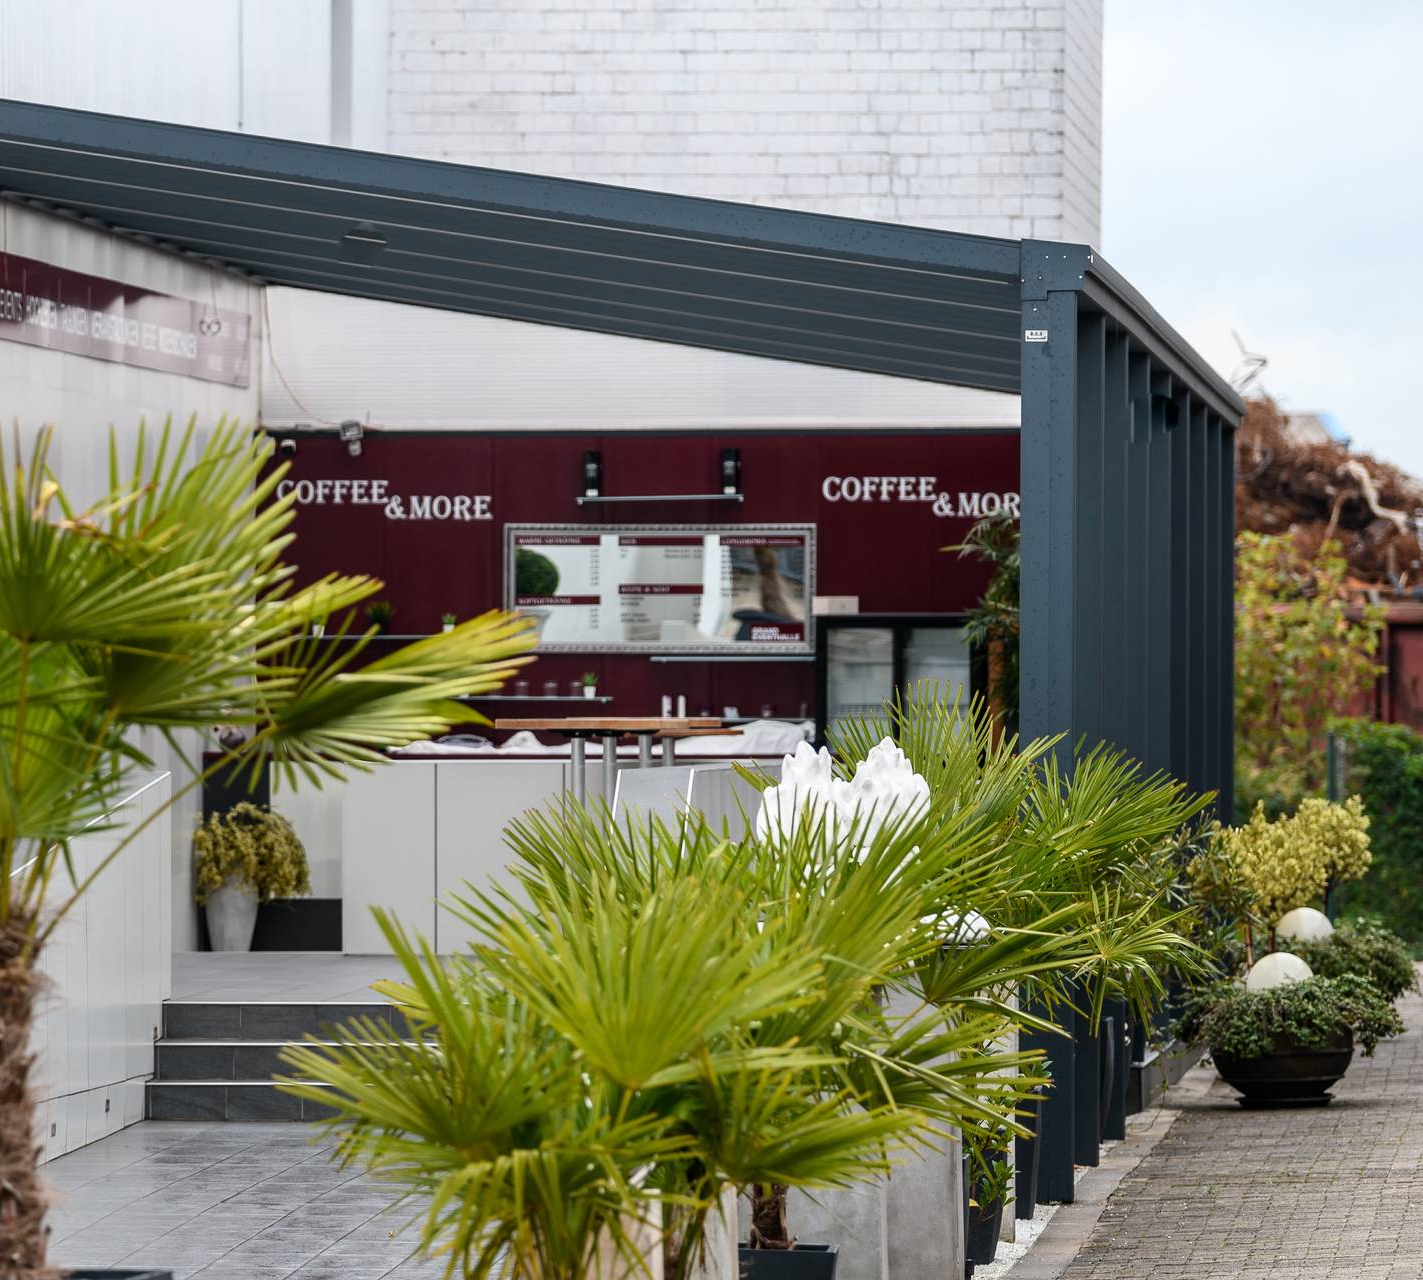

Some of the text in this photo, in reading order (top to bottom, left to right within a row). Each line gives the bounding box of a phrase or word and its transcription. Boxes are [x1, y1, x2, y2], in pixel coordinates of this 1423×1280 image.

[277, 479, 389, 505] COFFEE
[822, 476, 937, 502] COFFEE
[958, 492, 1020, 518] MOR
[752, 632, 801, 640] EVENTHALLE
